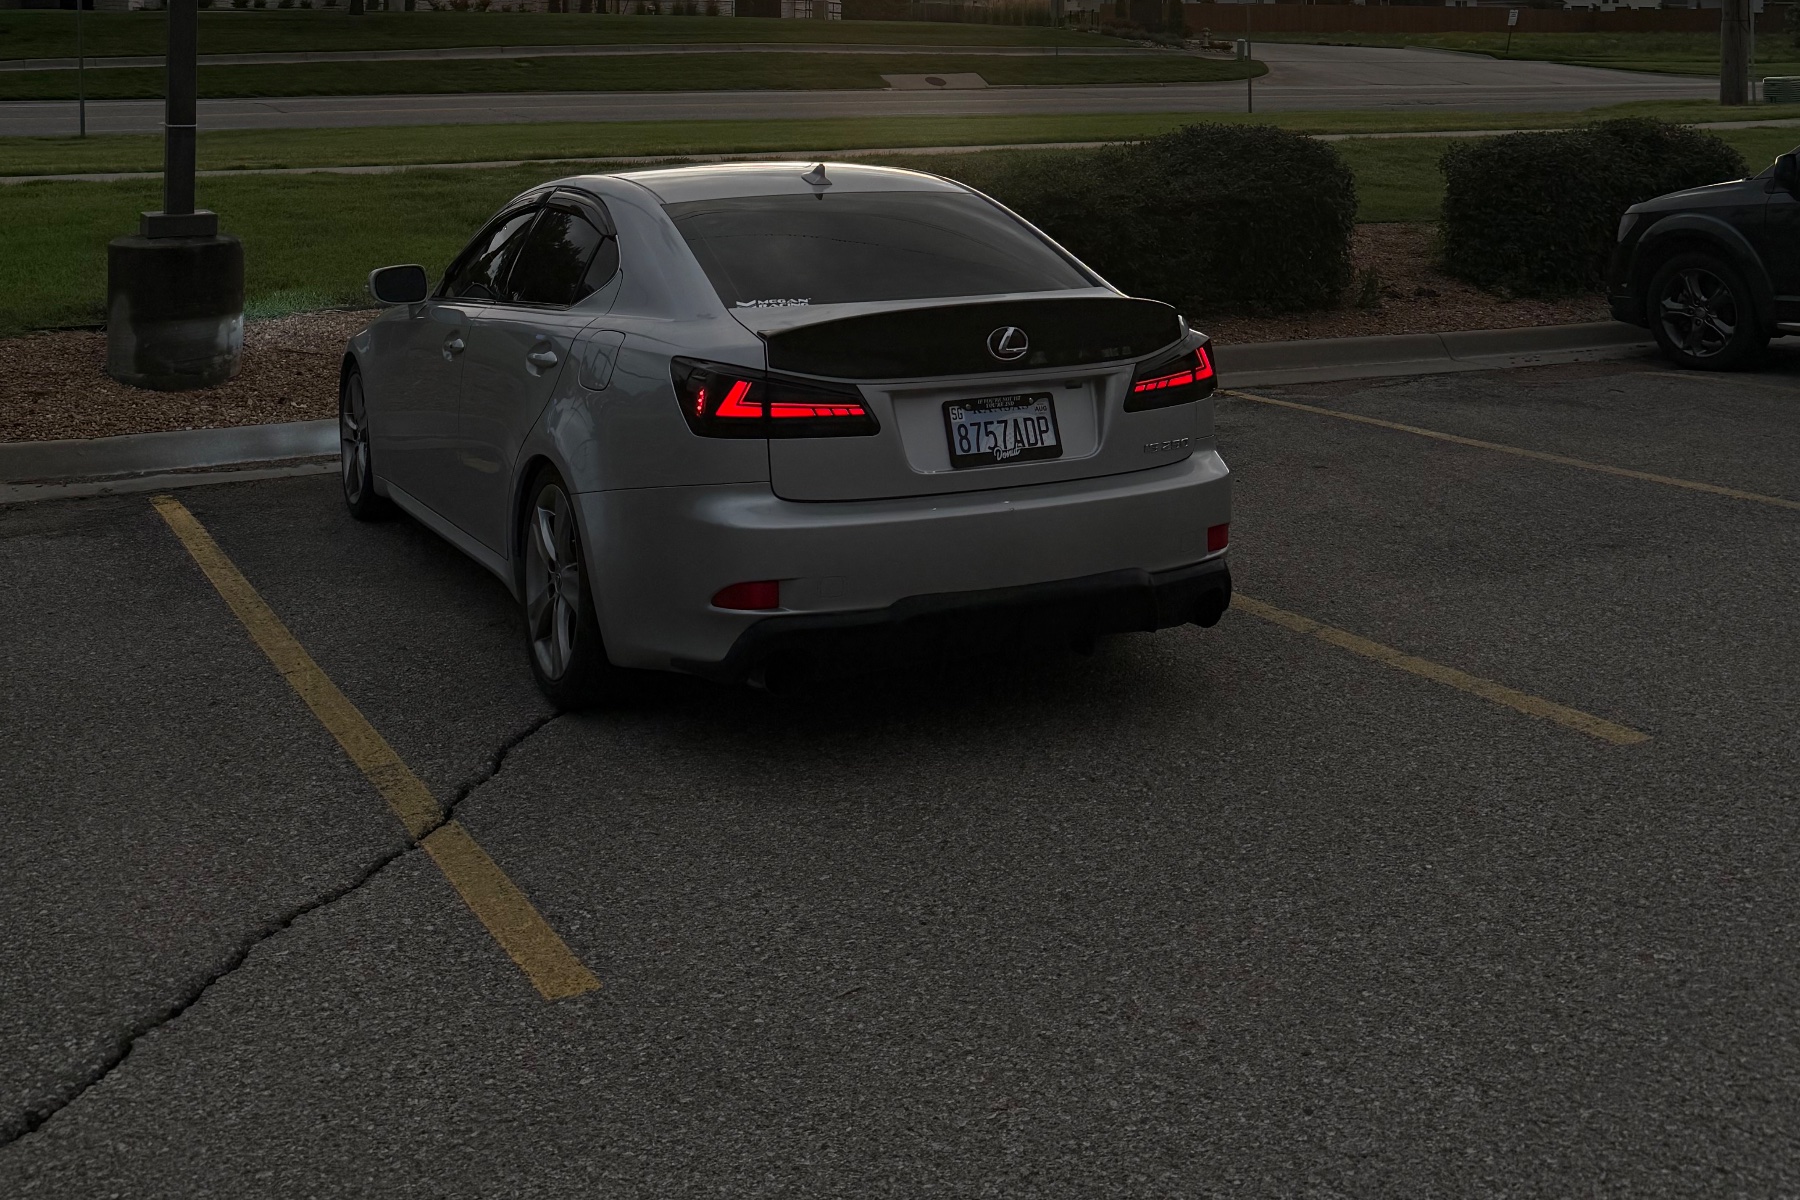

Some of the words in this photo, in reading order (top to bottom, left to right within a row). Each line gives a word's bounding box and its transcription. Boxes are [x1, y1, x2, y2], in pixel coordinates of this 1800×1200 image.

[951, 407, 963, 420] SG
[957, 416, 1050, 453] 8757ADP
[993, 444, 1022, 461] Donut
